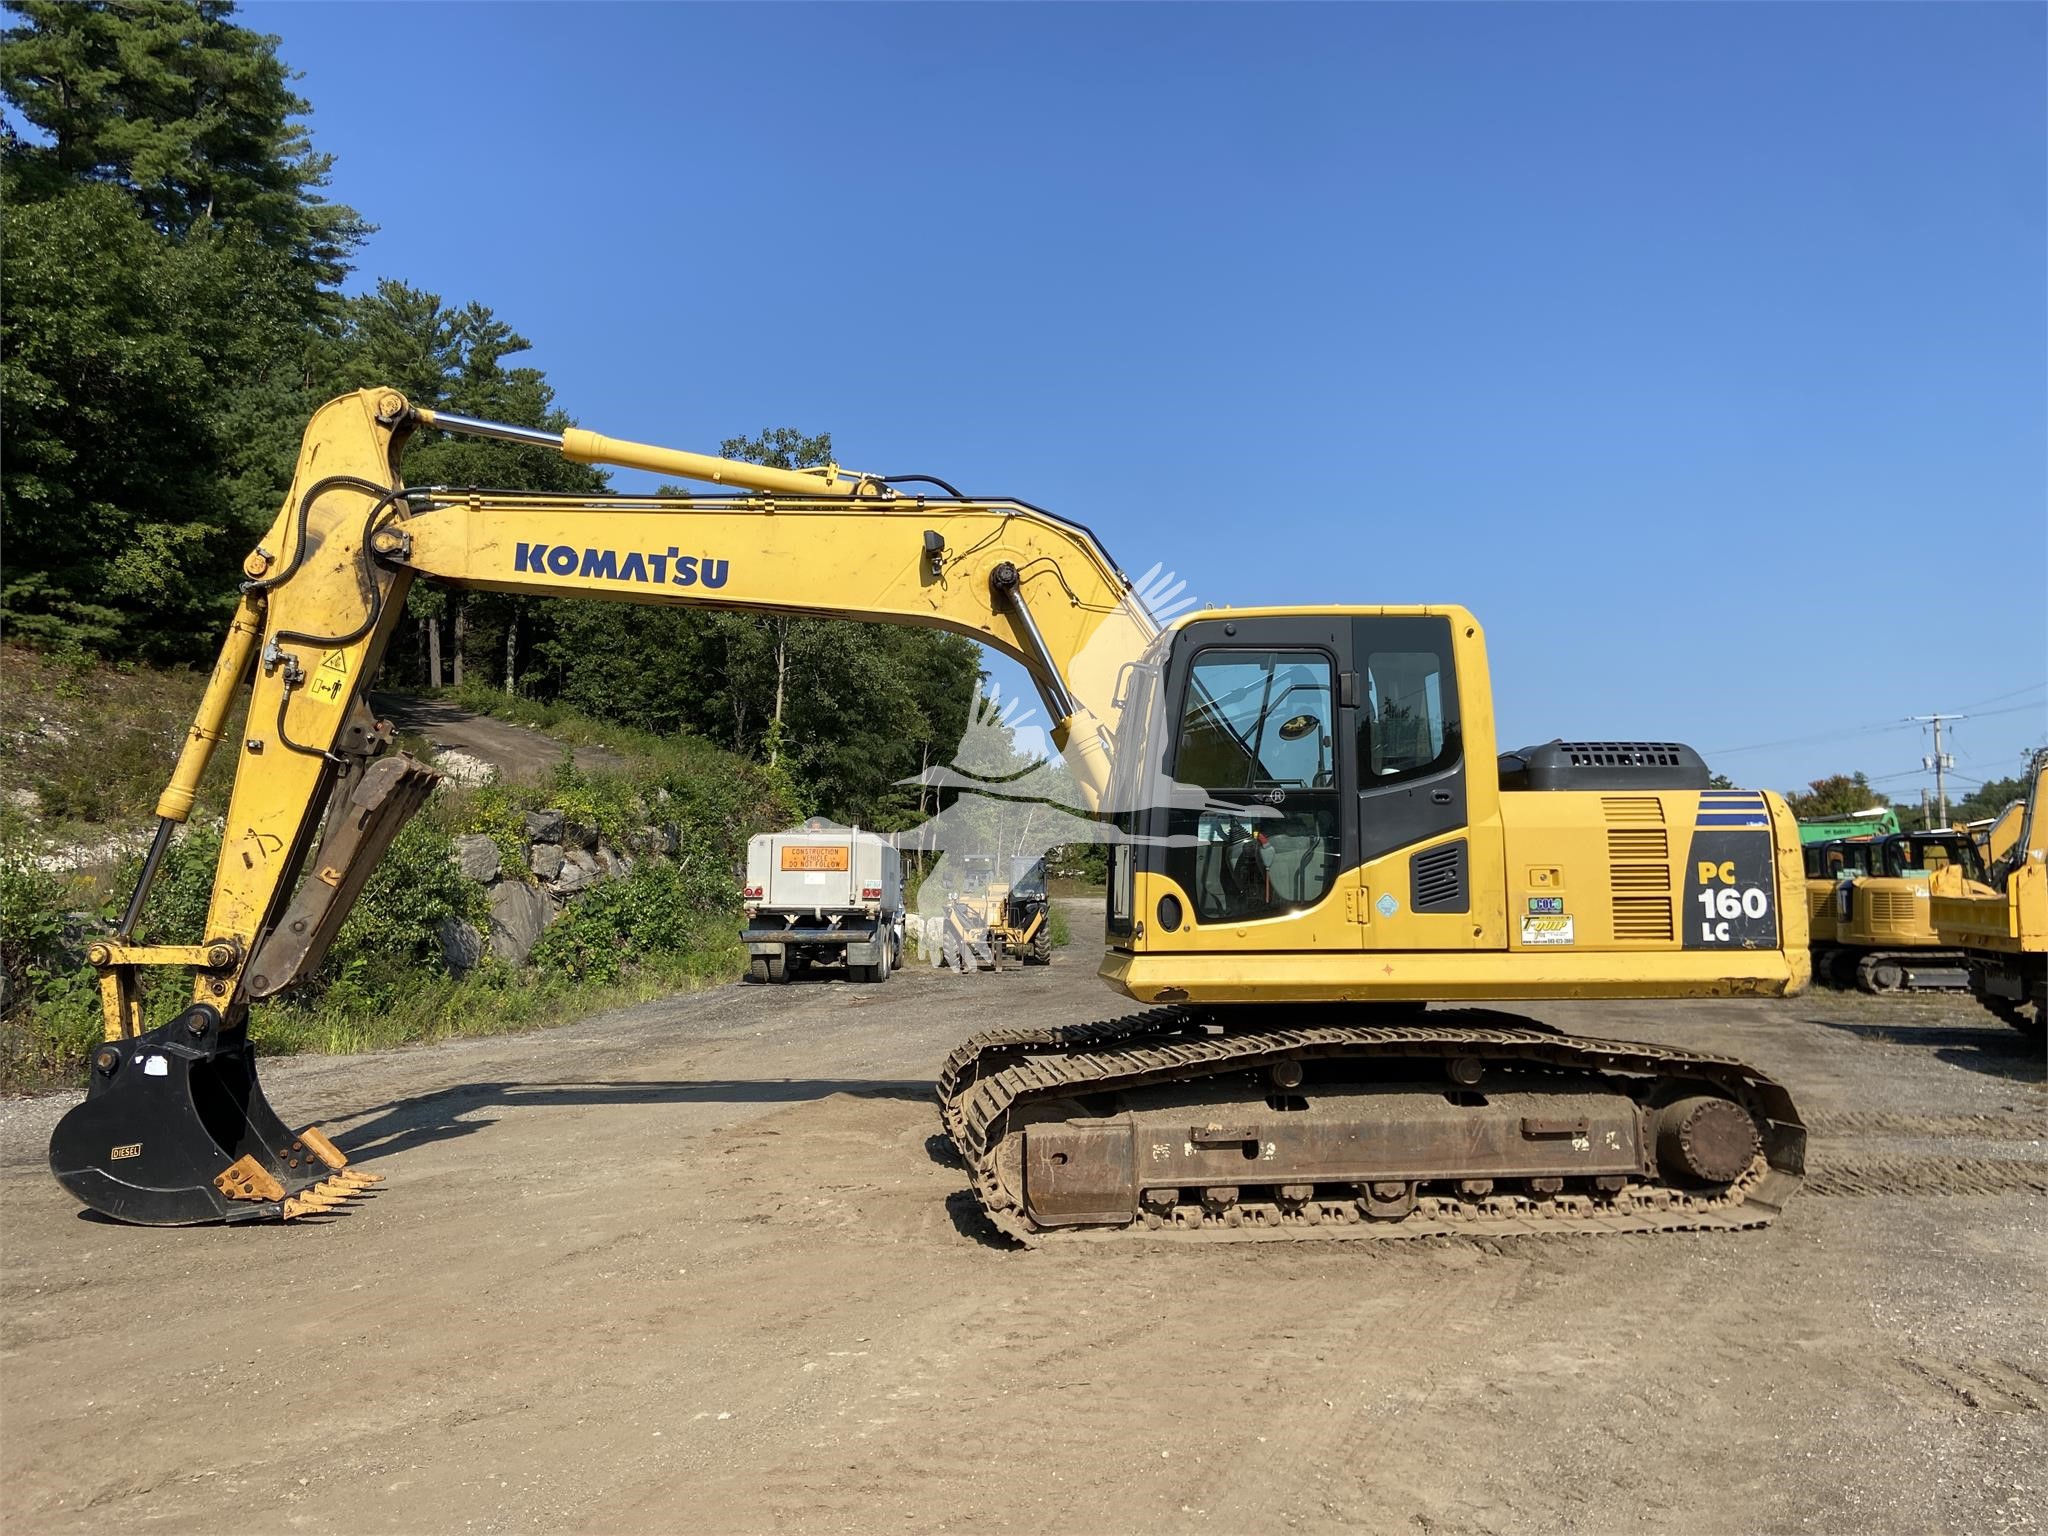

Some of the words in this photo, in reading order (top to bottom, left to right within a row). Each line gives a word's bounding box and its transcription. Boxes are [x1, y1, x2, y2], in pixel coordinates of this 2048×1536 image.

[514, 542, 729, 589] KOMATSU
[1698, 861, 1736, 885] PC
[1698, 887, 1768, 919] 160
[1702, 921, 1730, 941] LC
[113, 1146, 138, 1158] DIESEL
